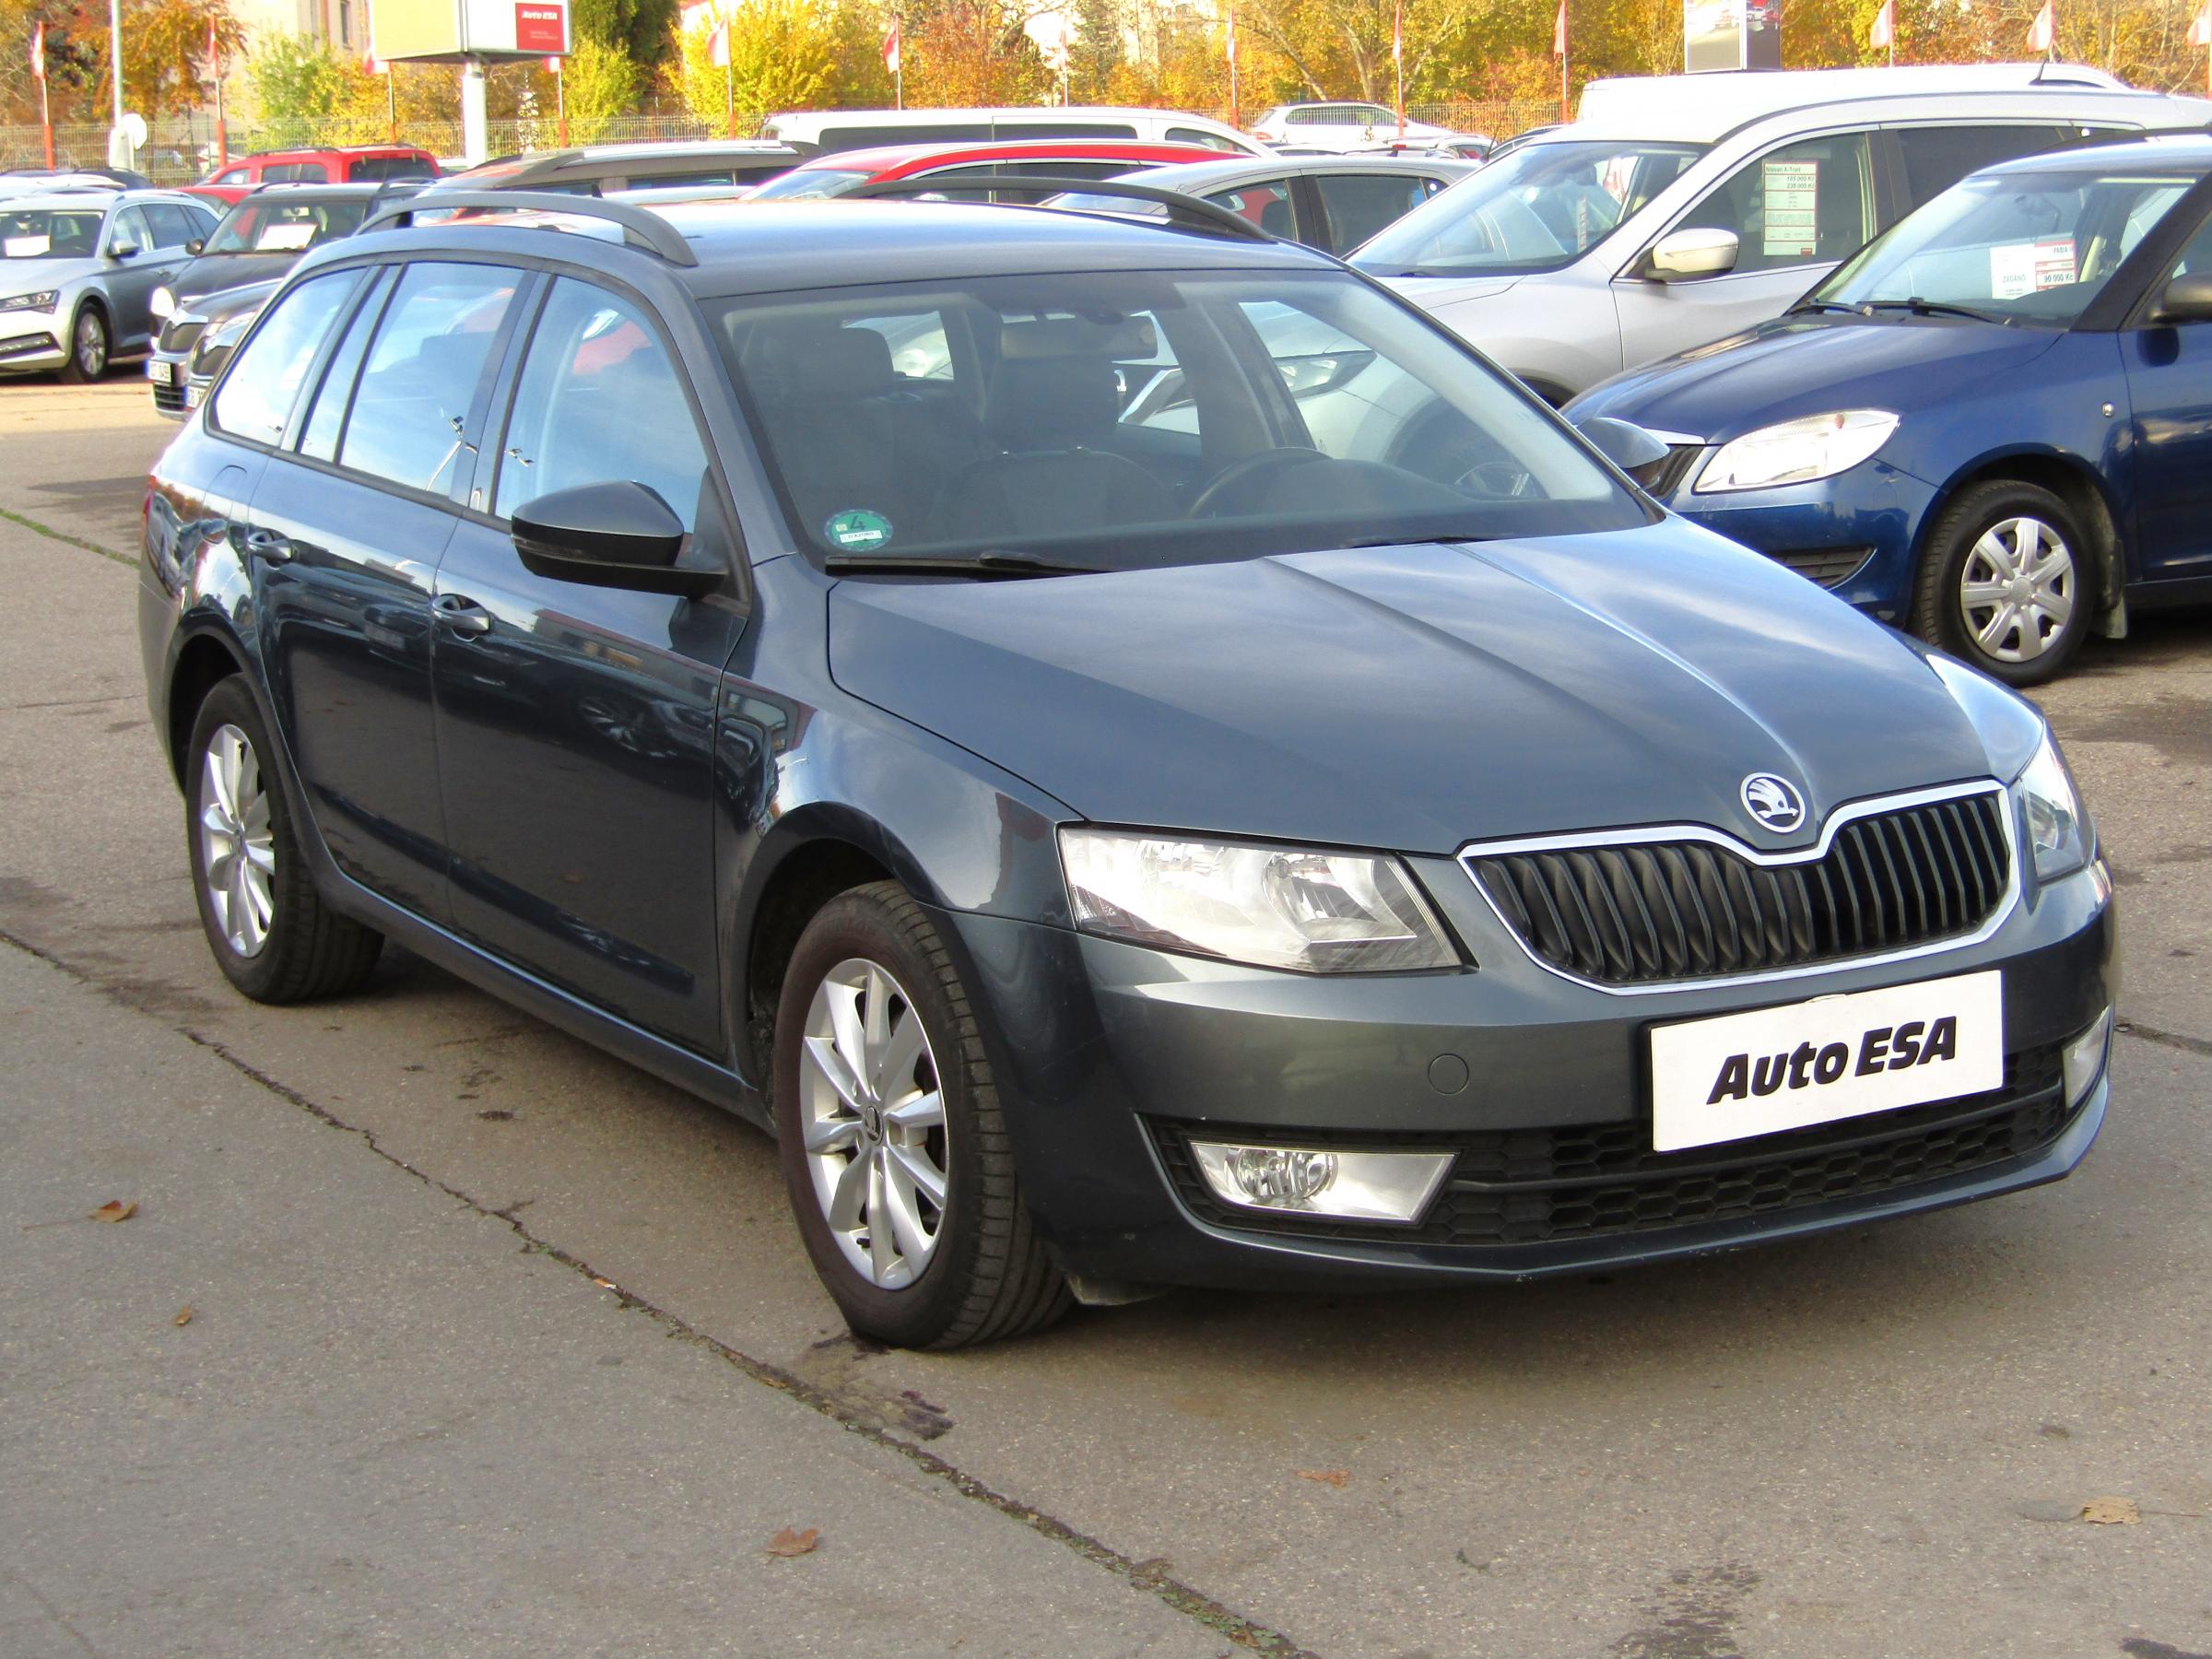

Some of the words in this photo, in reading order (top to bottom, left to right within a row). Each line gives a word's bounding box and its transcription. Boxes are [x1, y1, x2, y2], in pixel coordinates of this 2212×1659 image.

[522, 10, 542, 19] Auto
[542, 12, 558, 20] ESA
[2053, 273, 2064, 282] 000
[850, 515, 865, 530] 4
[1706, 1041, 1848, 1105] Auto
[1854, 1016, 1957, 1077] ESA
